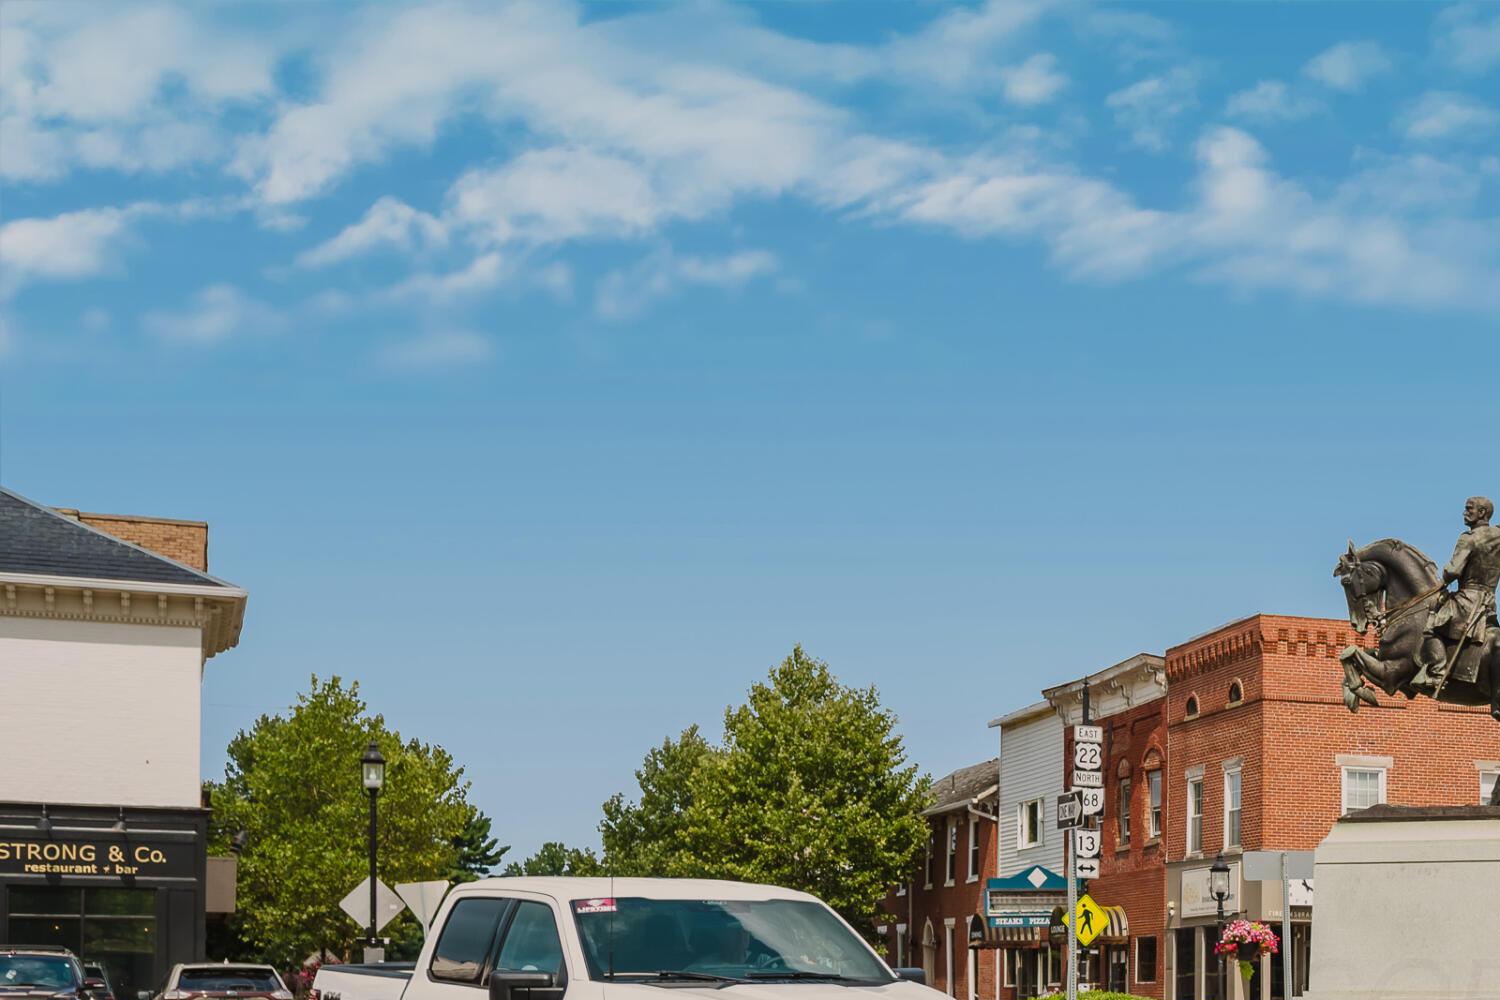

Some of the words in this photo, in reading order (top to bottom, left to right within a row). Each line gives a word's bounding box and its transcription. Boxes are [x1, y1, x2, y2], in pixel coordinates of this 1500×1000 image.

[1079, 728, 1098, 738] EAST
[1079, 747, 1098, 764] 22
[1075, 772, 1100, 783] NORTH
[1083, 793, 1099, 807] 68
[1078, 836, 1095, 852] 13
[0, 842, 97, 862] STRONG
[108, 845, 125, 862] &
[134, 846, 167, 863] Co.
[24, 863, 98, 874] restaurant
[115, 865, 139, 875] bar
[995, 917, 1024, 925] STEAKS
[1028, 917, 1051, 925] PIZZA
